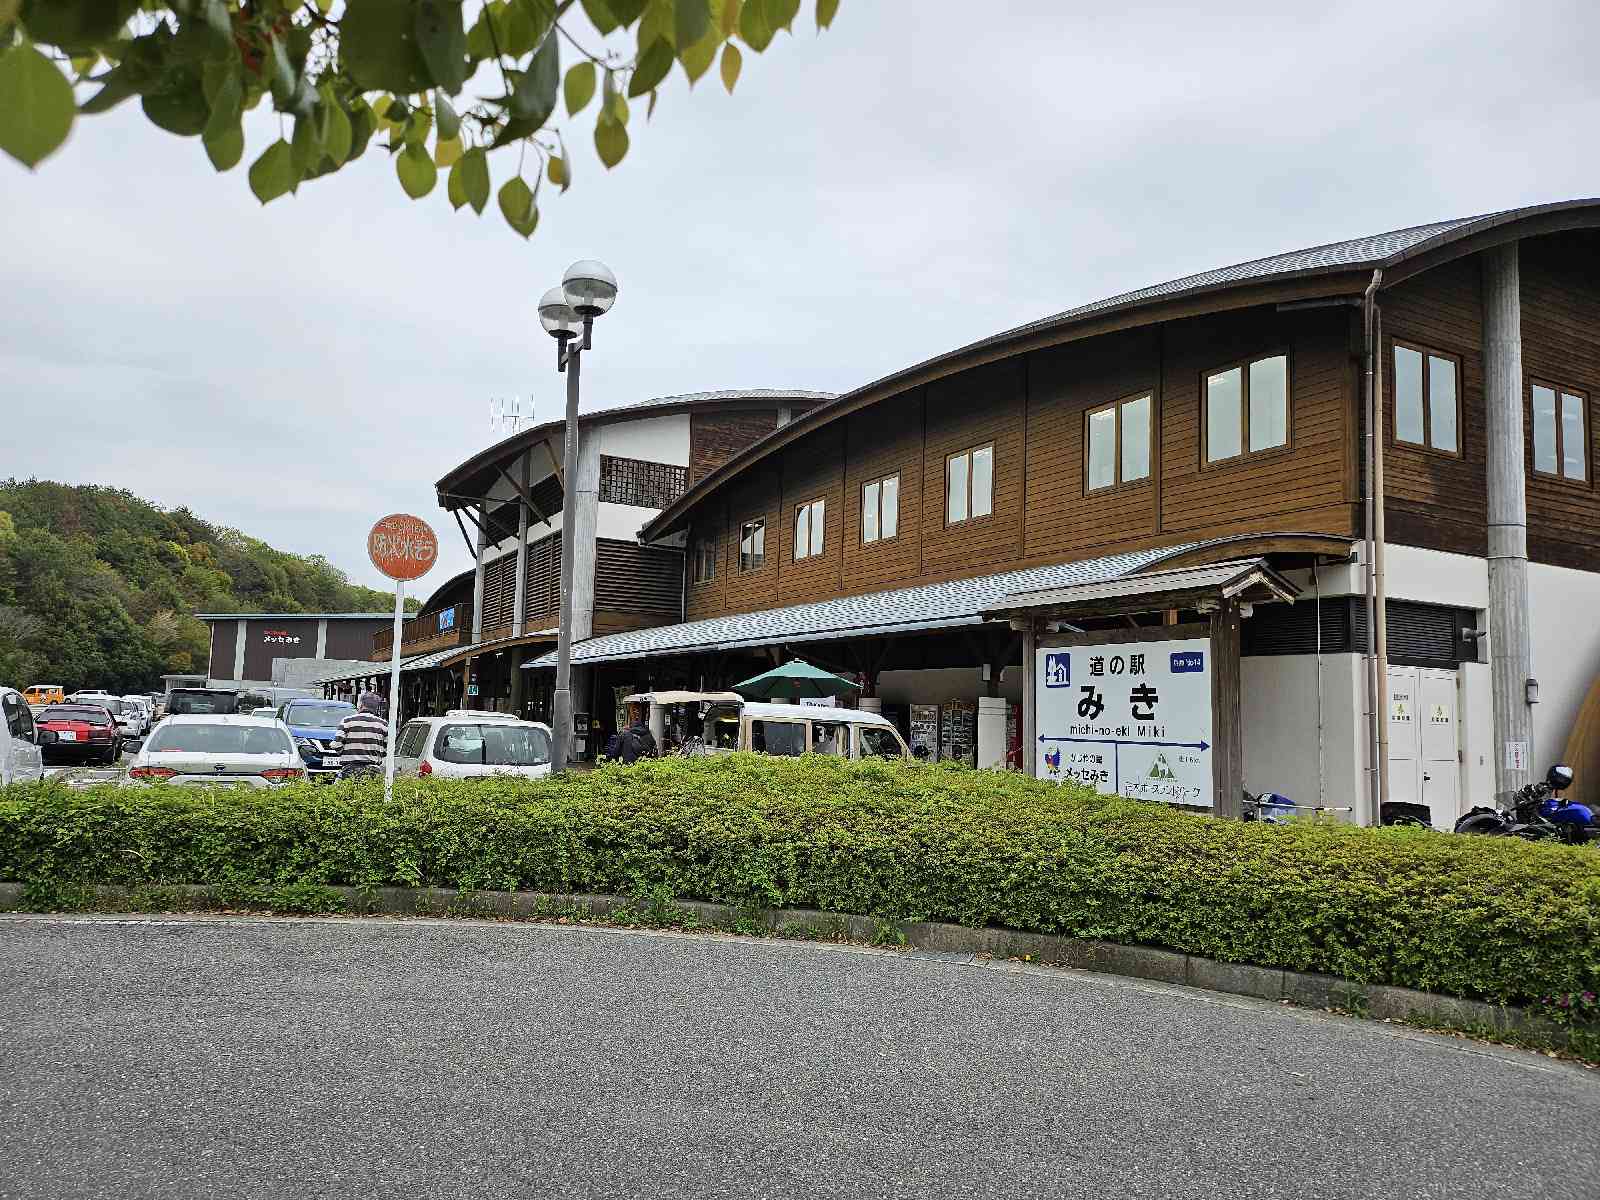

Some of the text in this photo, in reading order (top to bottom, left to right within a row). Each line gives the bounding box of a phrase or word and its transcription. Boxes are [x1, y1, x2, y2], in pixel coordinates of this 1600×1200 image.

[1089, 653, 1145, 676] 道の駅
[1078, 683, 1158, 720] みき
[1070, 724, 1165, 737] michi-no-eki Miki
[1064, 767, 1109, 783] メッセみき
